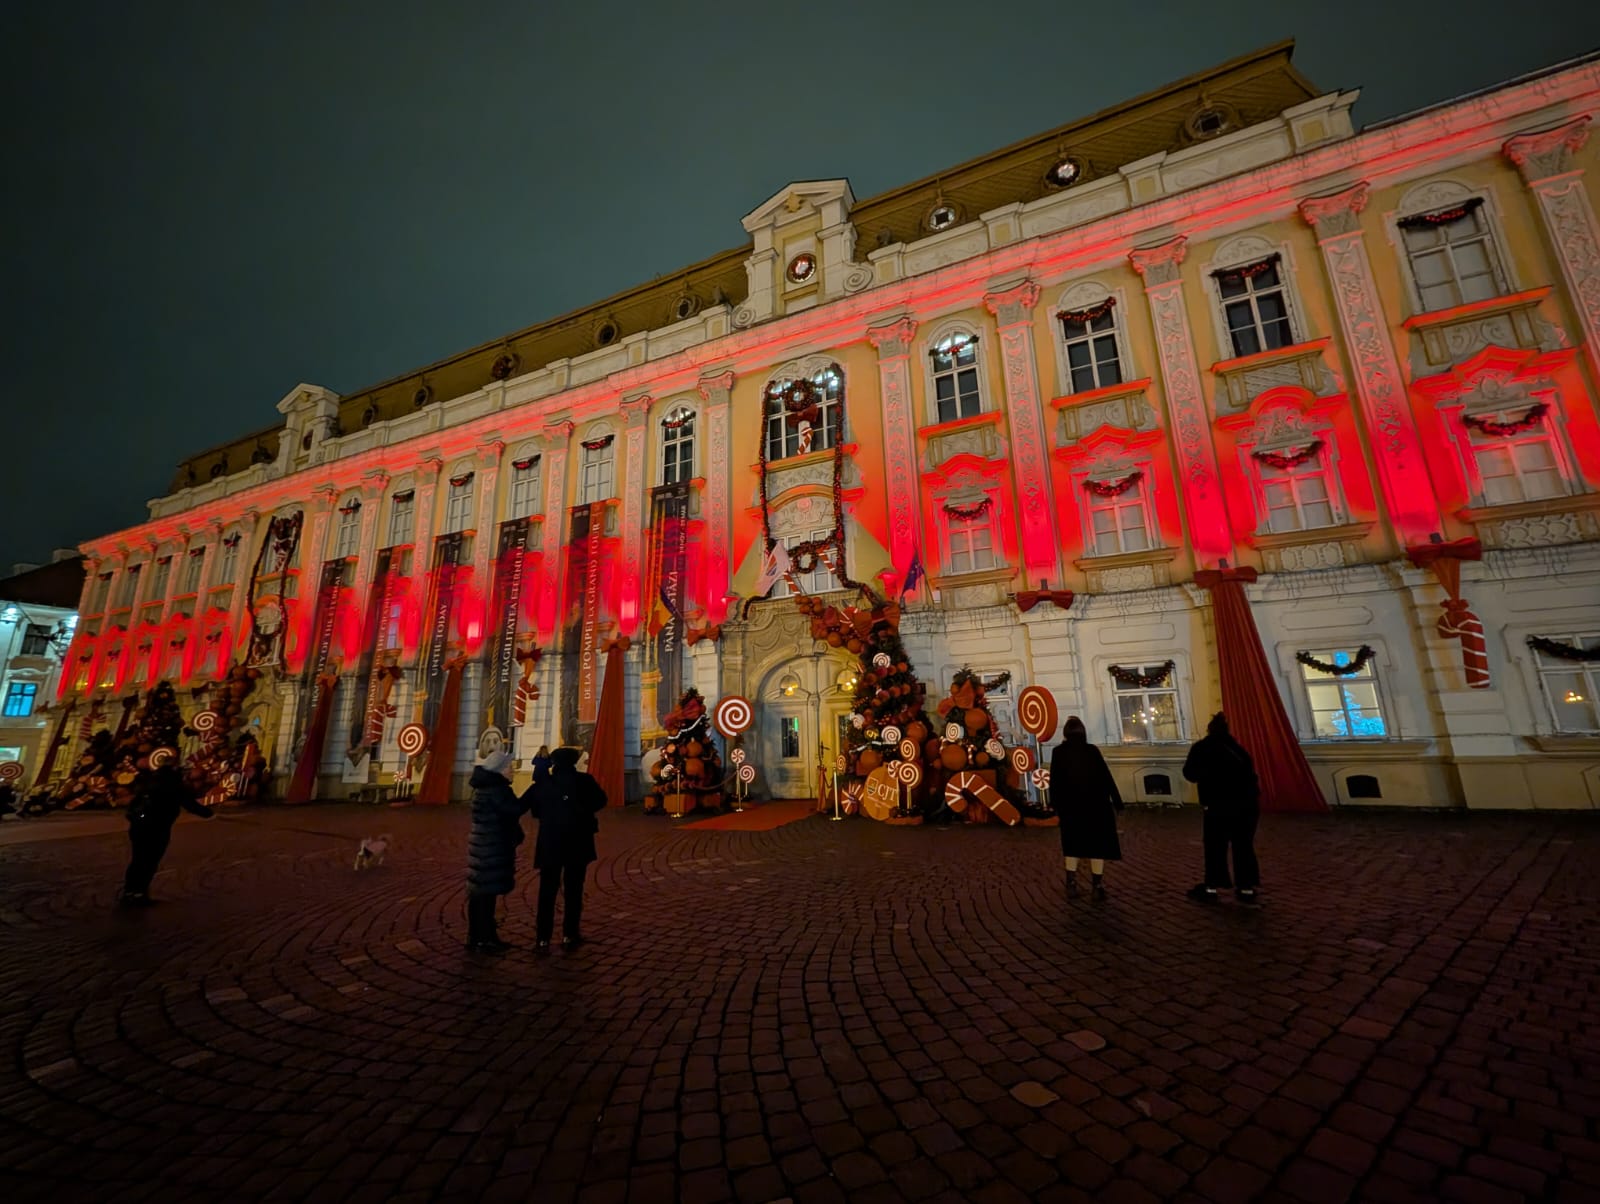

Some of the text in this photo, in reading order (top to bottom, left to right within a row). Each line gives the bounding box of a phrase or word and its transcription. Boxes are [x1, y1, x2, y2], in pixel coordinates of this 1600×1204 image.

[591, 523, 601, 555] TOUR
[588, 560, 599, 604] GRAND
[501, 538, 526, 682] FRAGILITATEA ETERNULUI
[431, 604, 448, 677] UNTIL TODAY
[583, 621, 594, 670] POMPEI
[584, 673, 592, 685] LA
[584, 688, 592, 700] DE
[878, 784, 898, 801] CJT
